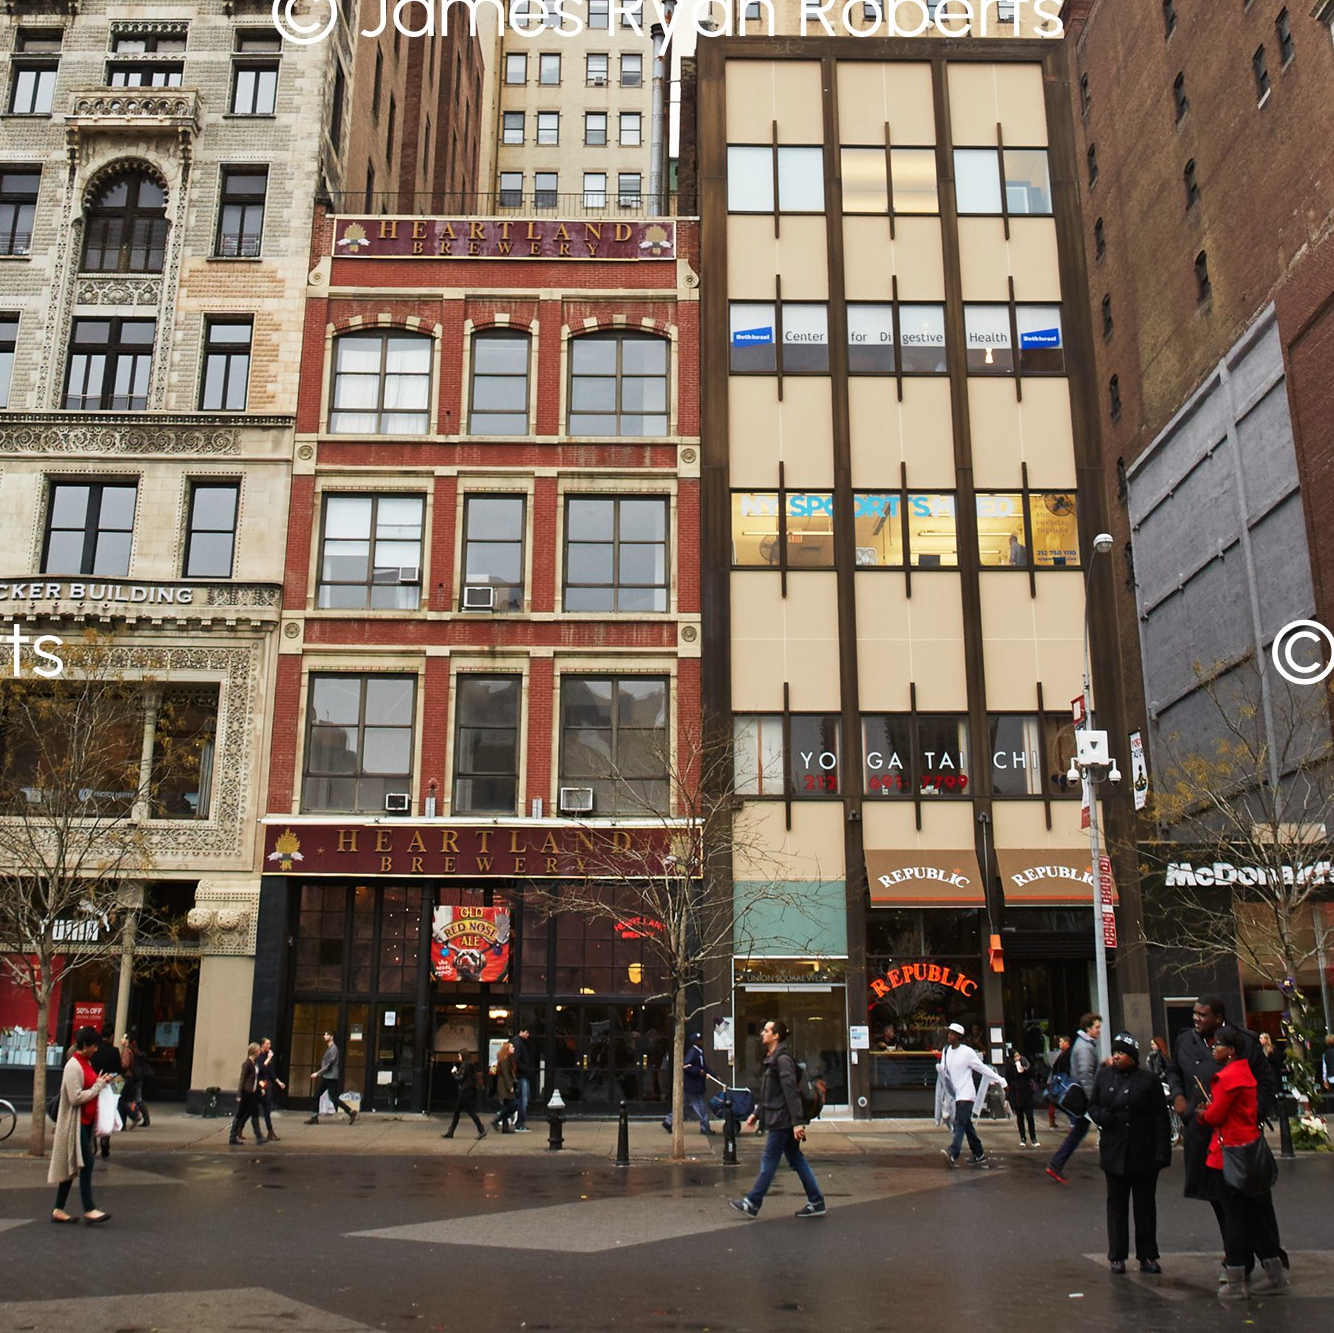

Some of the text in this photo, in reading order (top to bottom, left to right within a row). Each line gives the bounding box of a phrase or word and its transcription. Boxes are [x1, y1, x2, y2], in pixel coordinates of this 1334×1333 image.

[377, 220, 633, 243] HEARTLAND
[411, 241, 601, 257] BREWERY
[785, 331, 824, 342] Center
[851, 331, 867, 342] for
[969, 331, 1008, 343] Health
[68, 582, 194, 604] BUILDING
[924, 751, 965, 770] TAI
[993, 751, 1038, 770] CHI
[803, 774, 837, 791] 212
[335, 828, 633, 855] HEARTLAND
[379, 855, 589, 875] BREWERY
[877, 866, 971, 888] REPUBLIC
[460, 907, 484, 918] OLD
[444, 922, 496, 938] RED NOSE
[460, 935, 480, 947] ALE
[747, 974, 775, 982] UNION
[776, 974, 805, 983] SQUARE
[870, 962, 979, 999] REPUBLIC
